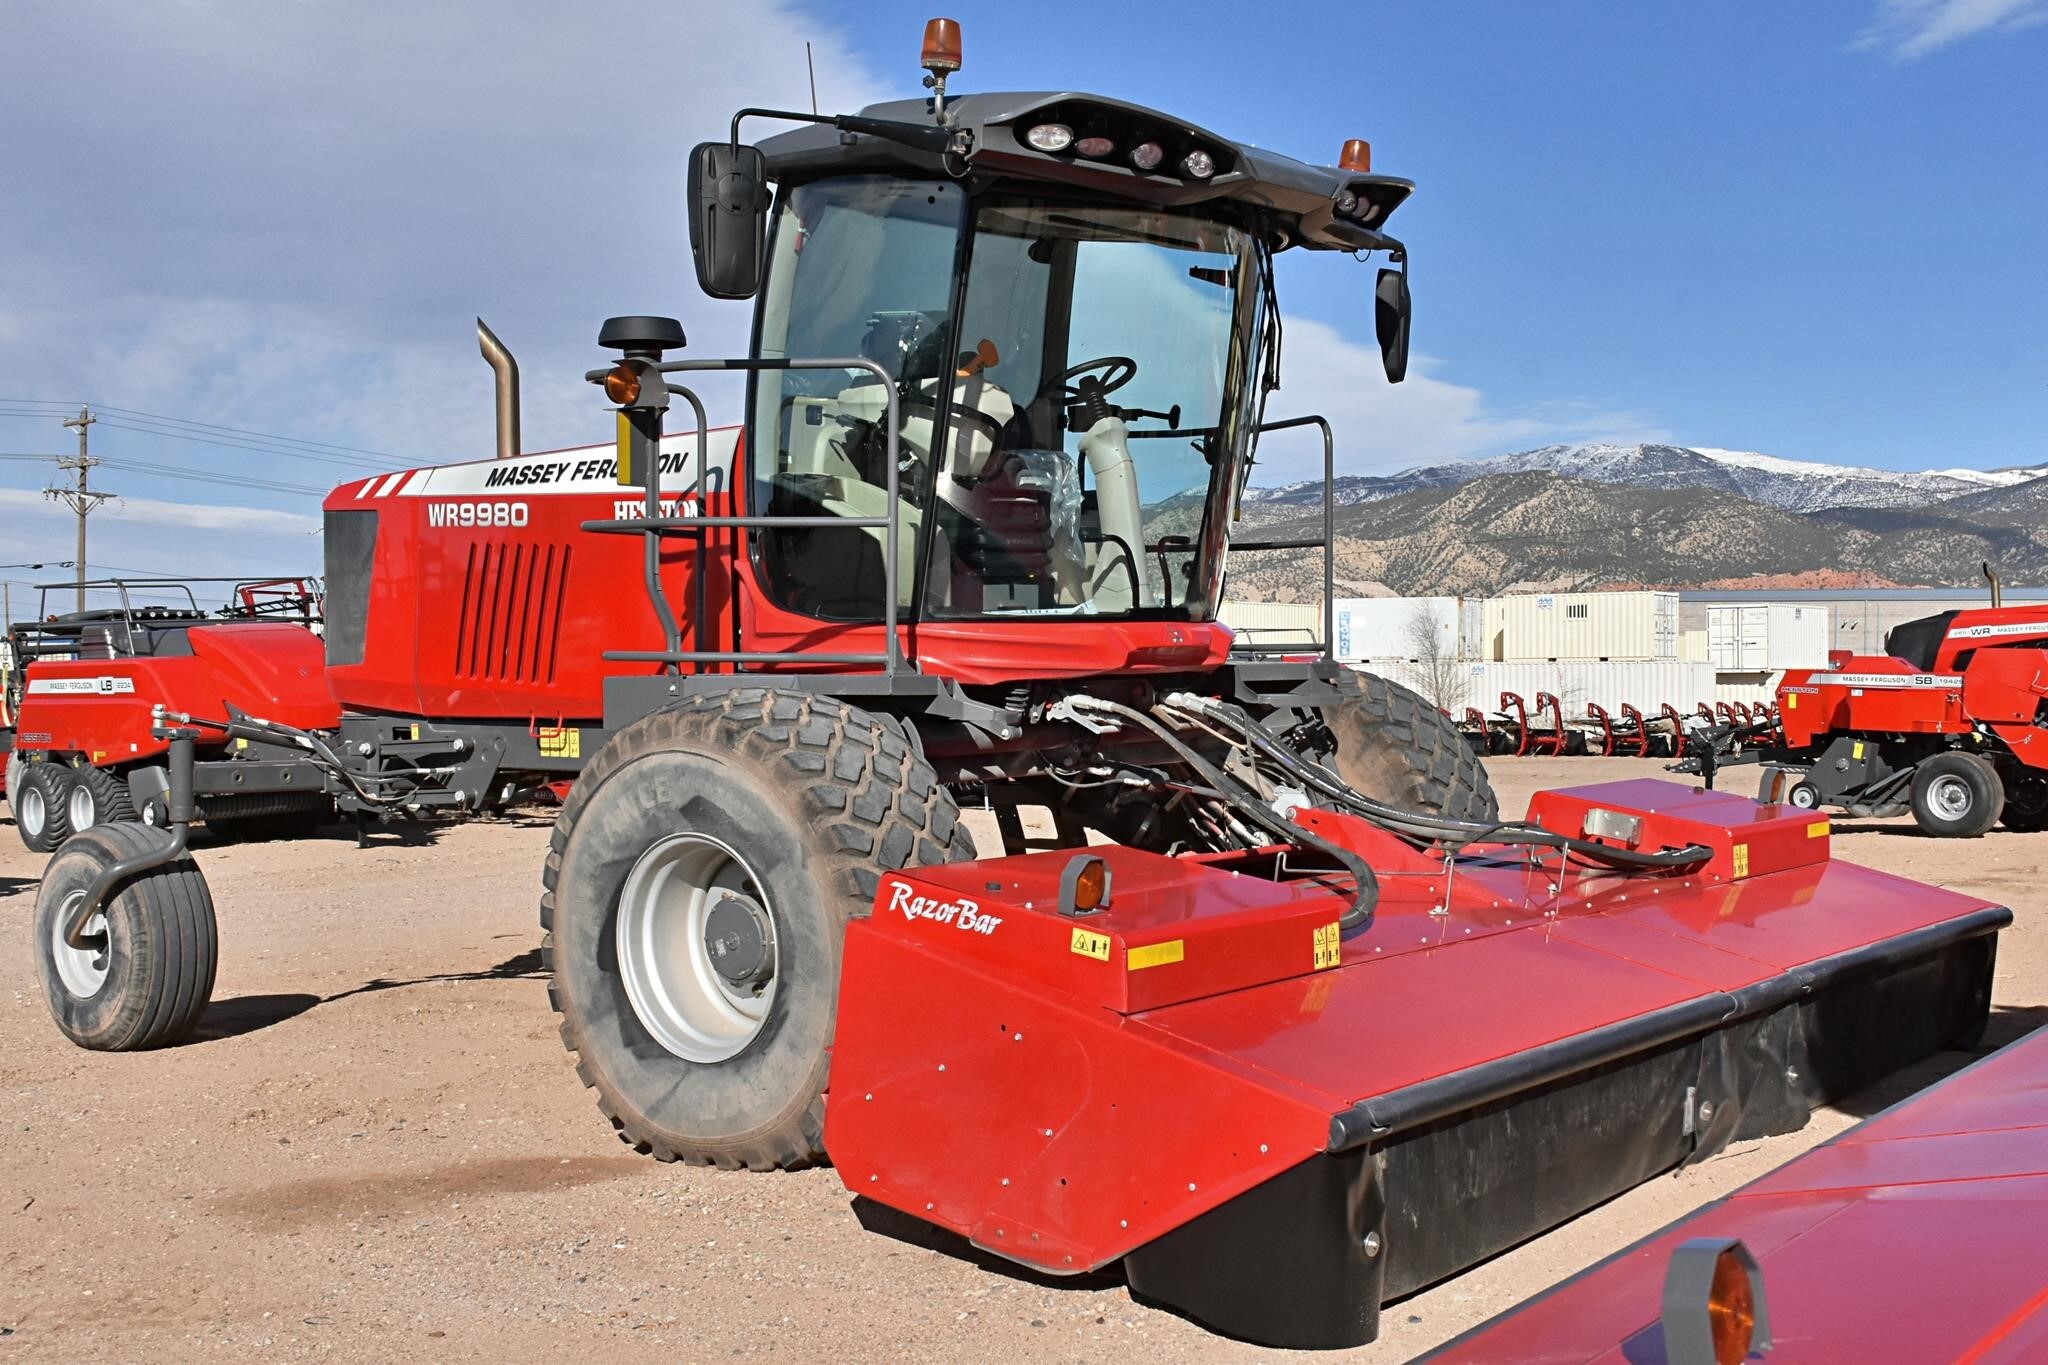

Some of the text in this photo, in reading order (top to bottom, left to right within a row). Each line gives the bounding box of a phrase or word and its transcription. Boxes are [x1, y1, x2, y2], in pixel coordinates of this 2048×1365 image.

[485, 452, 689, 488] MASSEY FERON
[428, 502, 528, 527] WR9980
[1971, 627, 1990, 635] WR
[50, 682, 68, 690] MASSEY
[69, 682, 93, 690] FERGUSON
[101, 680, 113, 691] LB
[1915, 676, 1933, 685] SB
[889, 880, 1003, 935] RazorBar
